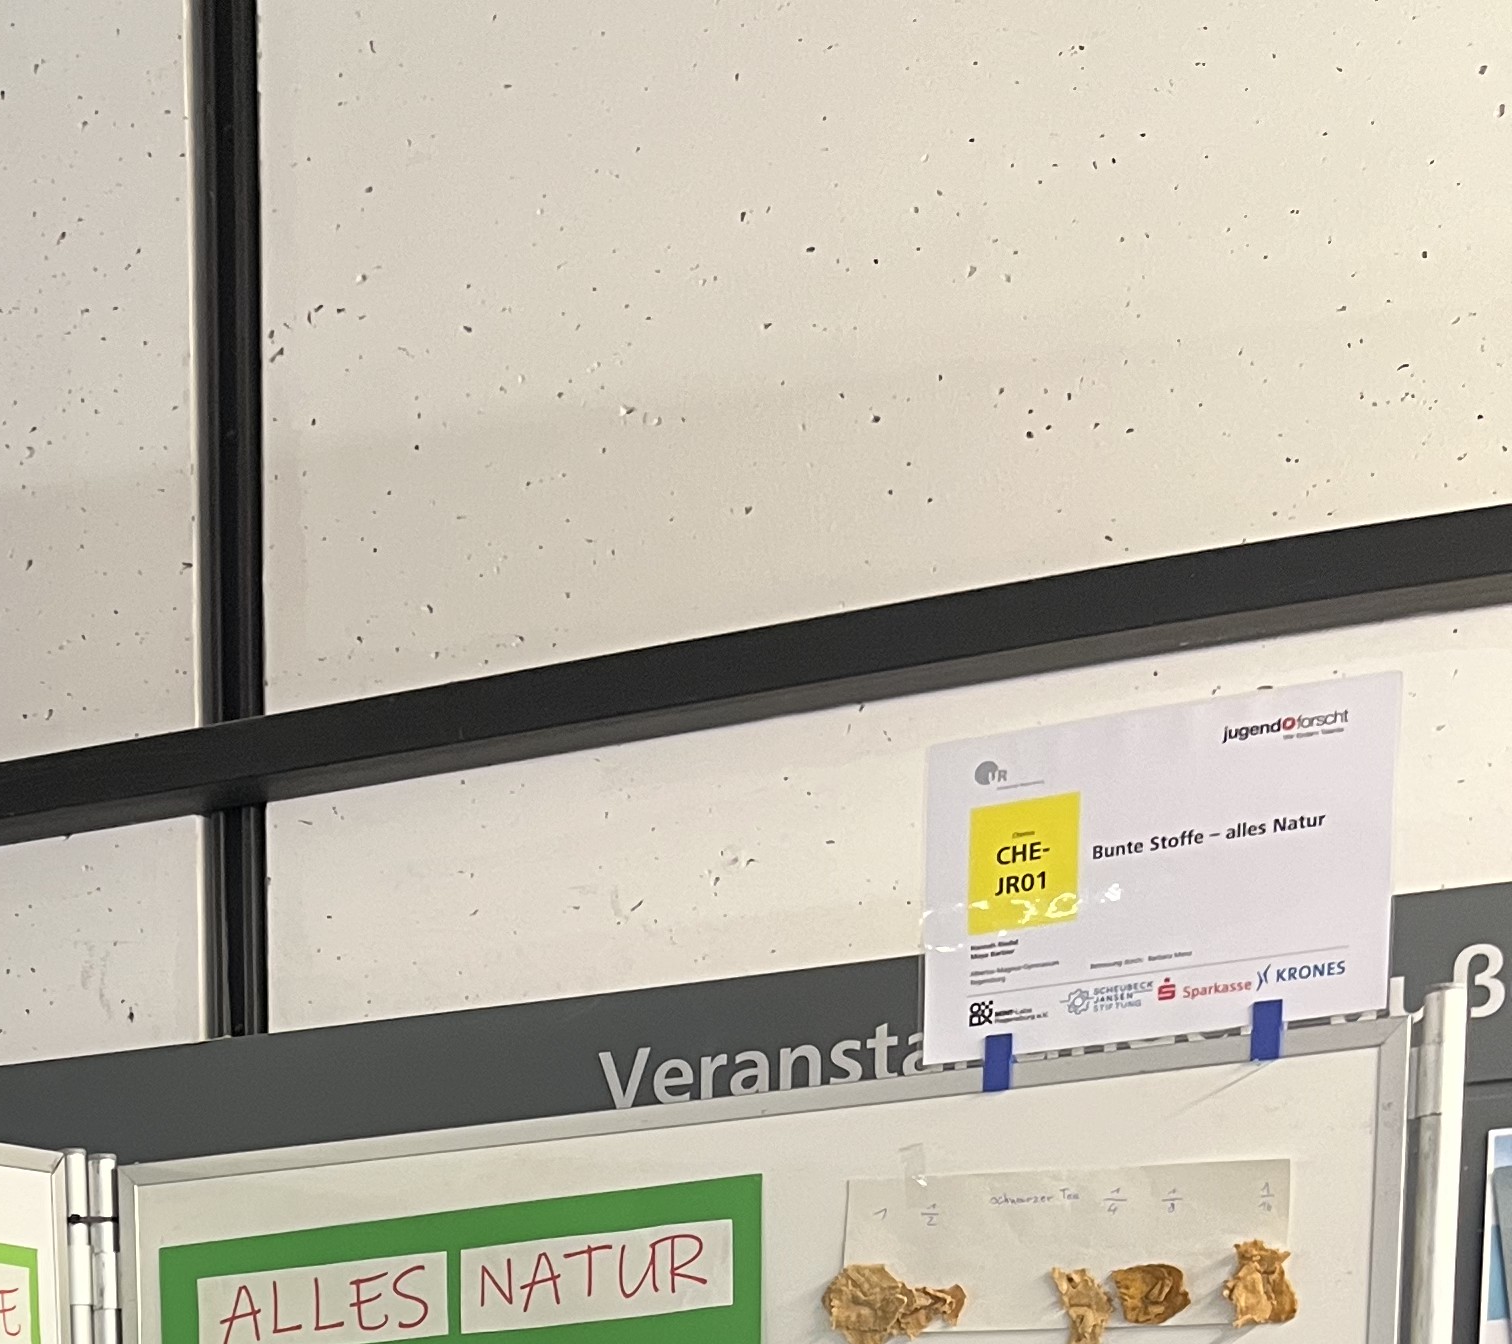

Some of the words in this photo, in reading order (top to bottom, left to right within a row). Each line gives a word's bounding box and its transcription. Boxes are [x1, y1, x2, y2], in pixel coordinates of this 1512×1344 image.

[1222, 718, 1282, 744] jugend
[1092, 838, 1144, 861] Bunte
[1150, 829, 1204, 853] Stoffe
[1225, 819, 1267, 842] alles
[1273, 811, 1326, 835] Natur
[996, 841, 1051, 865] CHE-
[994, 871, 1046, 897] JR01
[1275, 960, 1346, 984] KRONES
[1093, 980, 1154, 996] SCHEUBECK
[1093, 992, 1134, 1005] JANSEN
[1182, 978, 1252, 1001] Sparkasse
[599, 1020, 938, 1109] Veransta
[479, 1233, 708, 1313] NATUR
